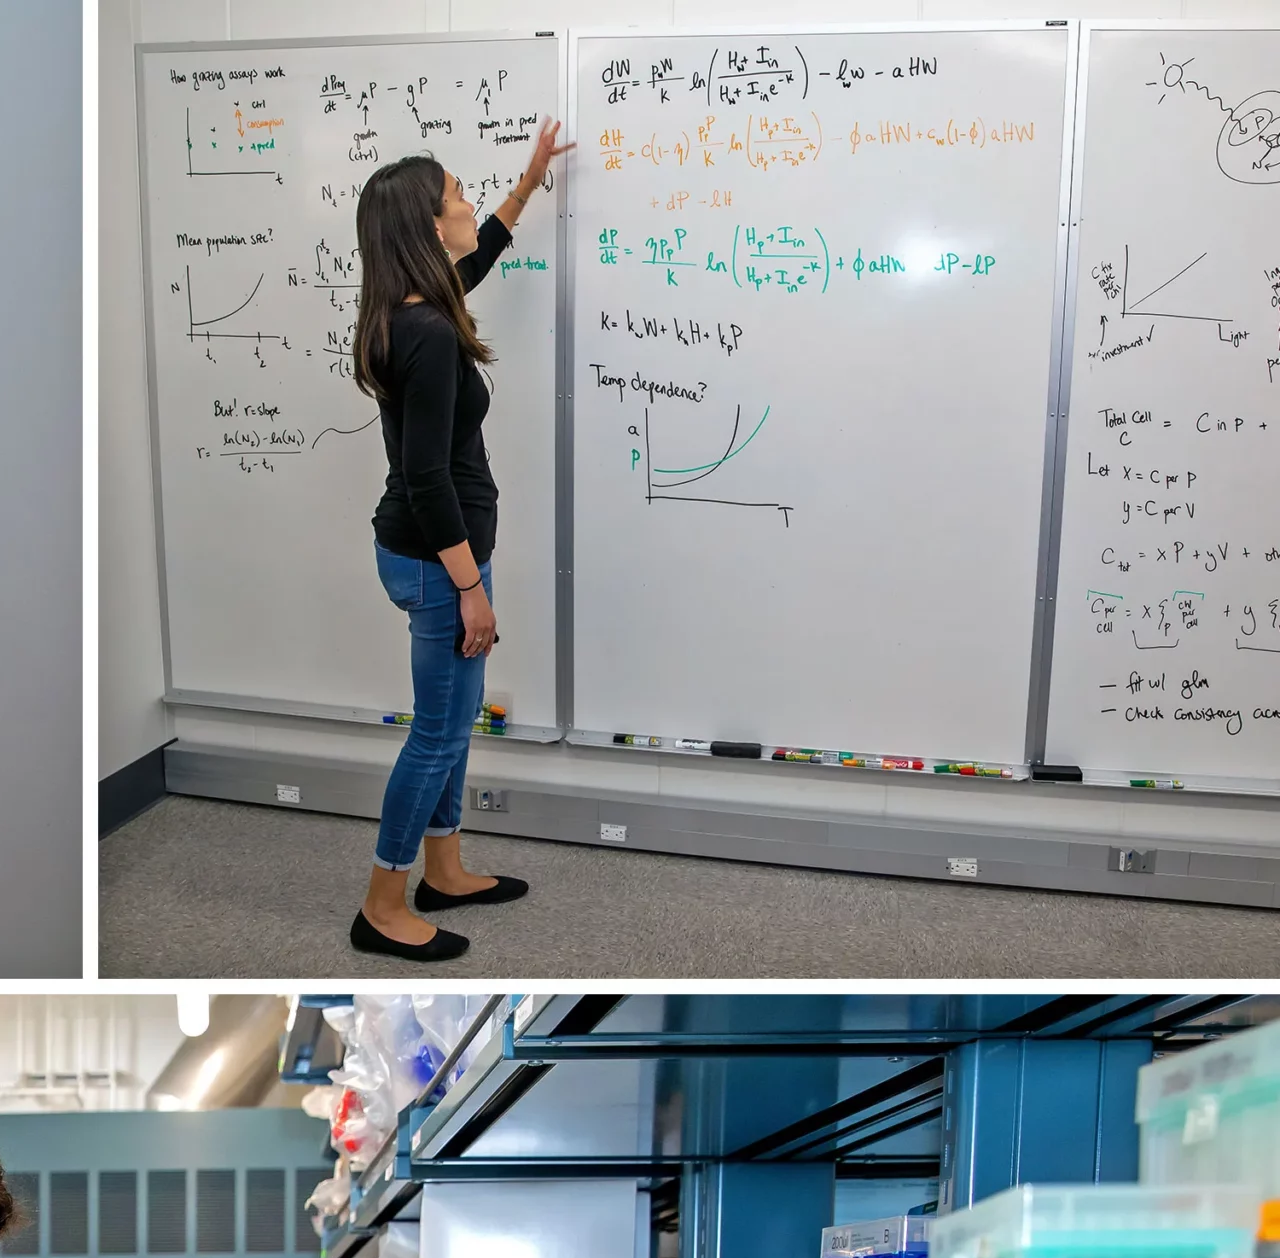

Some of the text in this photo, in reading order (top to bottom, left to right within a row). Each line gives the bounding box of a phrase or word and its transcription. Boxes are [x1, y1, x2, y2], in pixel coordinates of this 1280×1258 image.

[192, 71, 225, 91] grazing
[229, 69, 258, 84] assays
[265, 66, 285, 78] work
[247, 118, 284, 135] consumption
[420, 118, 452, 138] grazing
[519, 113, 537, 132] pred
[493, 133, 531, 146] treatment
[349, 145, 379, 162] (ctrl)
[177, 234, 202, 248] Mean
[206, 234, 247, 257] population
[500, 257, 522, 279] pred
[1218, 323, 1250, 348] Light
[1101, 336, 1144, 362] investment
[589, 364, 708, 403] Temp dependence?
[214, 398, 238, 418] But!
[1098, 408, 1127, 428] Total
[1131, 410, 1152, 424] Cell
[1217, 420, 1227, 431] in
[1088, 451, 1110, 477] Let
[1166, 475, 1179, 490] per
[778, 506, 794, 528] T
[1164, 506, 1181, 525] per
[1126, 670, 1144, 695] fit
[1180, 669, 1209, 699] glm
